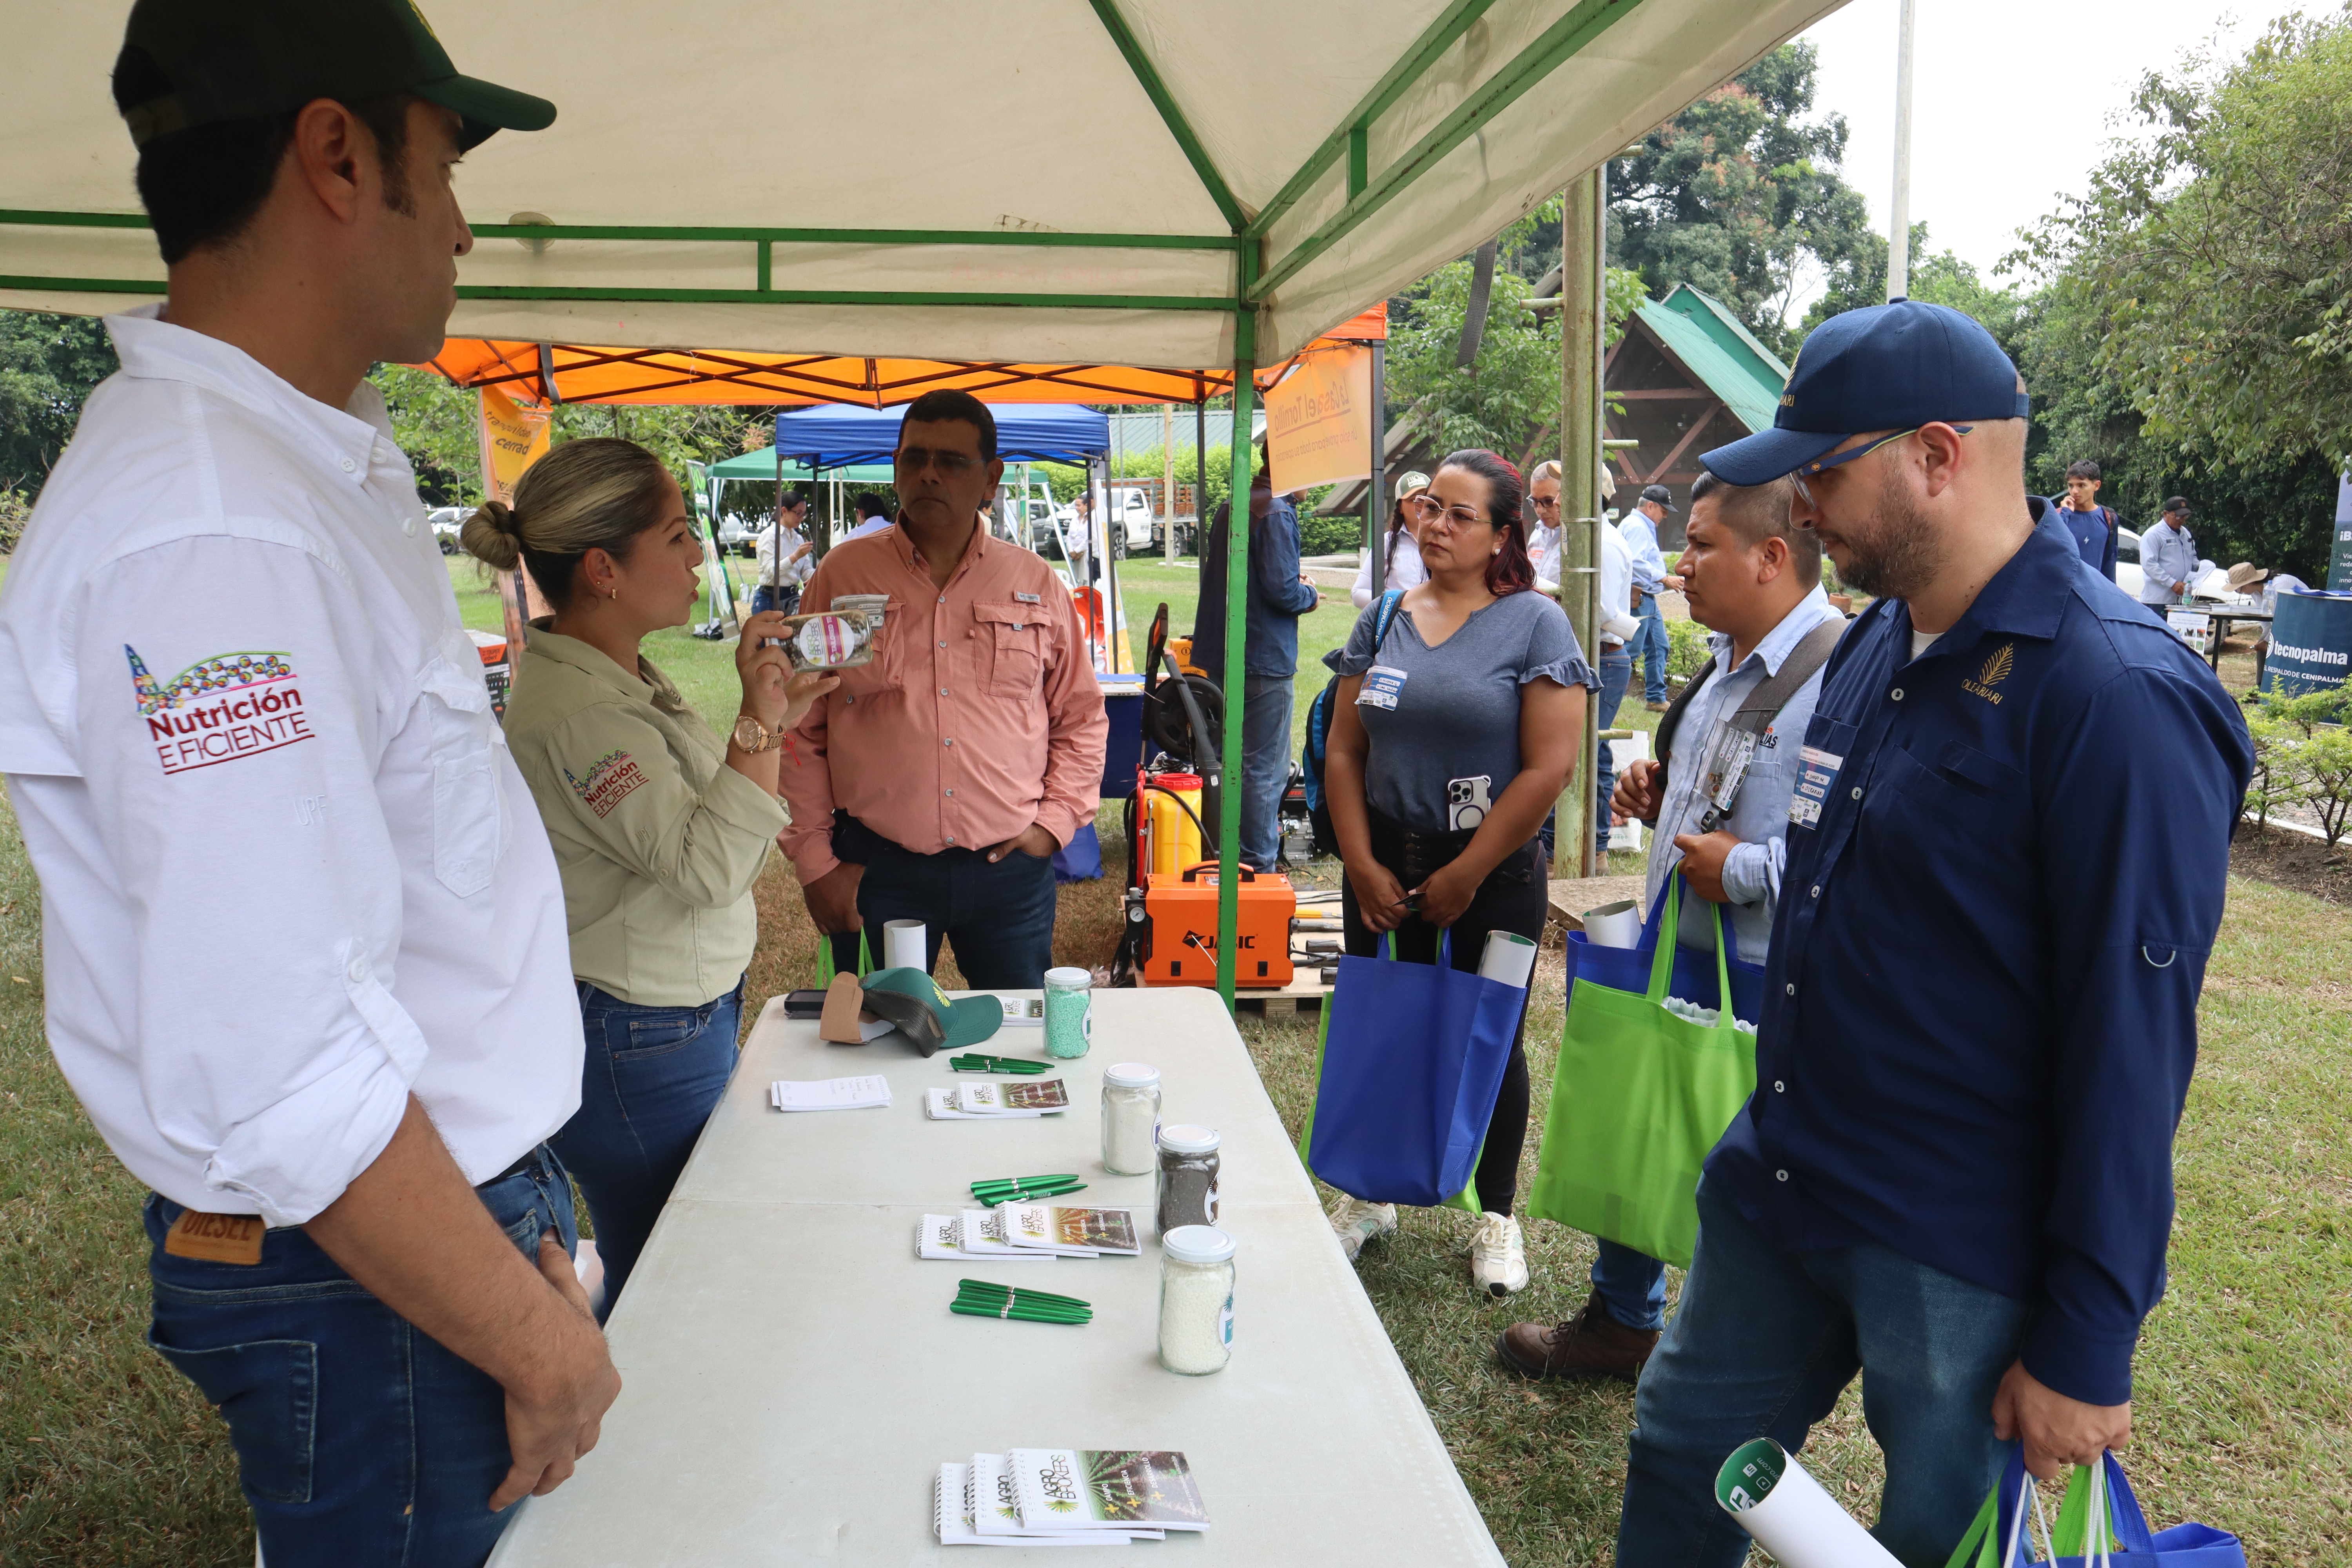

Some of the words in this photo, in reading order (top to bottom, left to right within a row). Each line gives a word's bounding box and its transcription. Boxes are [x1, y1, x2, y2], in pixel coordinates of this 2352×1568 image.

[2339, 531, 2352, 541] iB
[2274, 641, 2348, 665] tecnopalma
[2268, 666, 2291, 677] RESPALDO
[2301, 673, 2345, 684] CENIPALMA
[147, 688, 302, 741] Nutrición
[157, 711, 310, 768] EFICIENTE
[1760, 735, 1778, 747] LIAS
[584, 762, 638, 806] Nutrición
[593, 771, 646, 816] EFICIENTE
[974, 1090, 984, 1100] AGRO
[981, 1221, 994, 1235] AGRO
[1021, 1214, 1032, 1229] AGRO
[1032, 1208, 1044, 1231] BROKERS
[940, 1226, 950, 1241] AGRO
[1040, 1468, 1058, 1497] AGRO
[1052, 1453, 1076, 1499] BROKERS
[1122, 1469, 1134, 1495] EFICIENCIA
[1142, 1457, 1158, 1488] DESARROLLO
[998, 1475, 1011, 1503] AGRO
[1102, 1483, 1112, 1501] CAMPO
